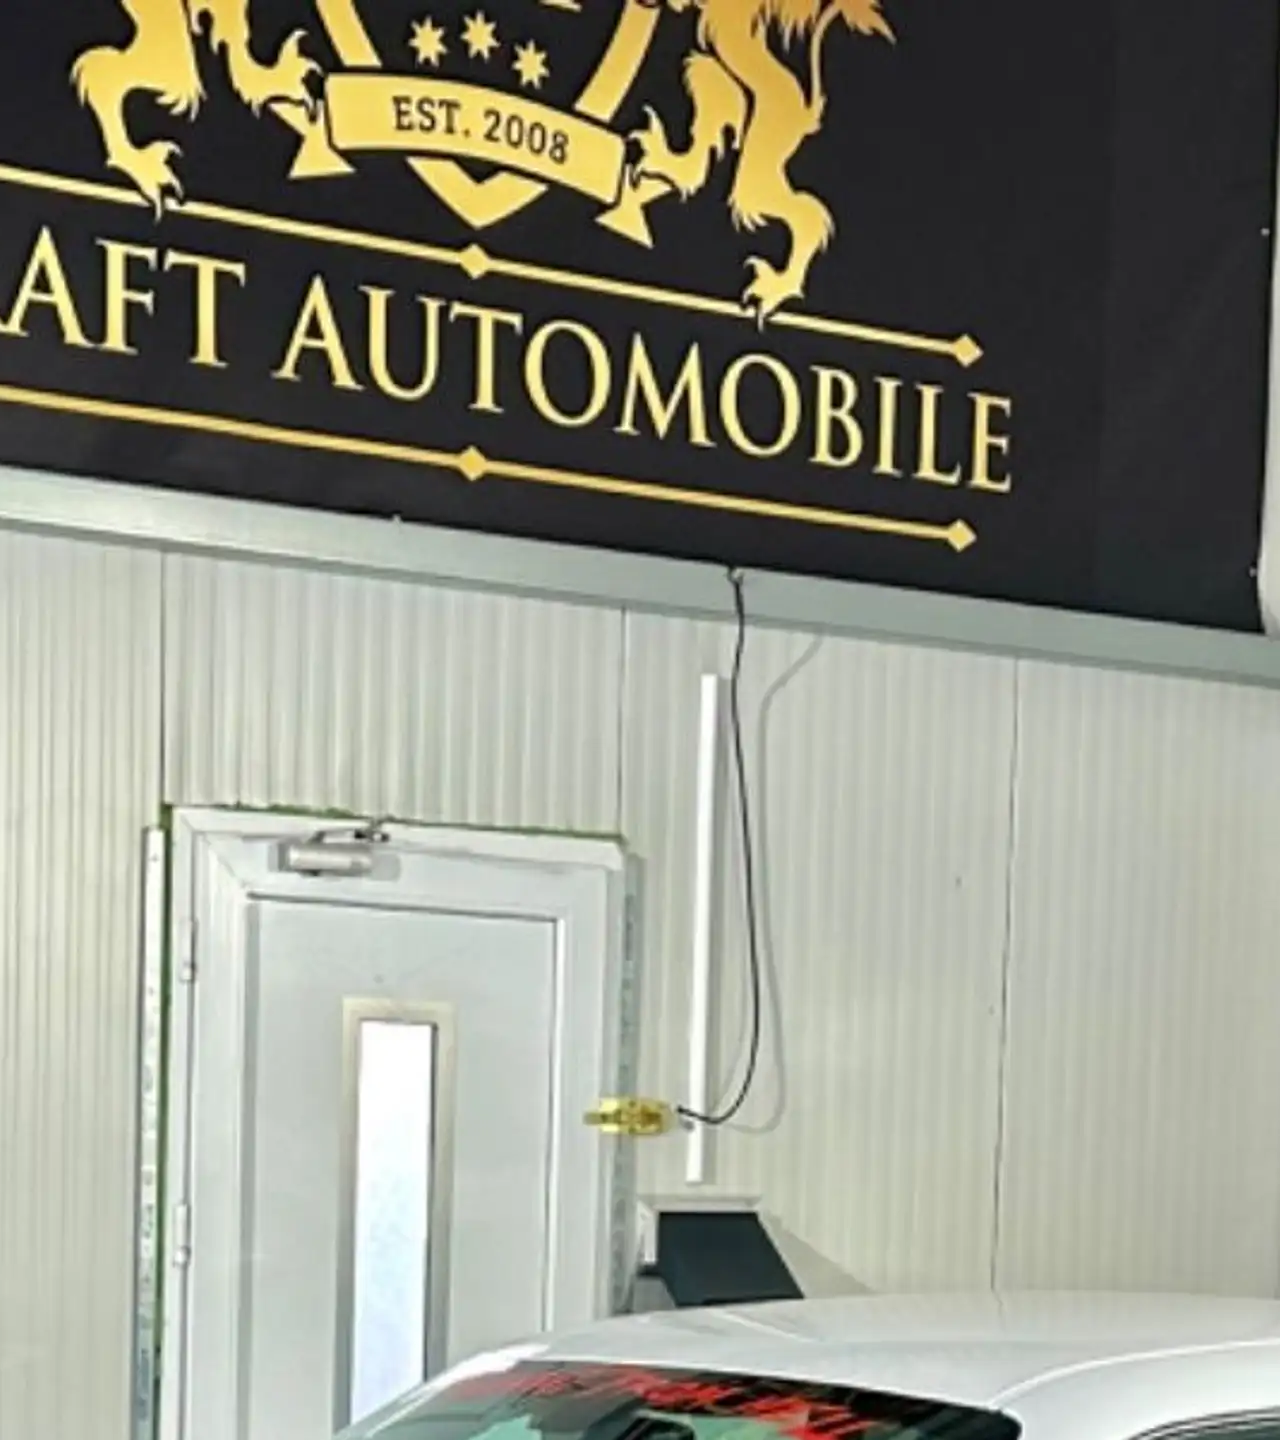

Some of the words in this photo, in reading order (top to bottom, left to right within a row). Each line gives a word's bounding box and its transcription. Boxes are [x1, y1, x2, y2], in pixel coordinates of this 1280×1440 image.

[391, 95, 471, 138] EST.
[483, 109, 570, 165] 2008
[271, 275, 1014, 496] AUTOMOBILE
